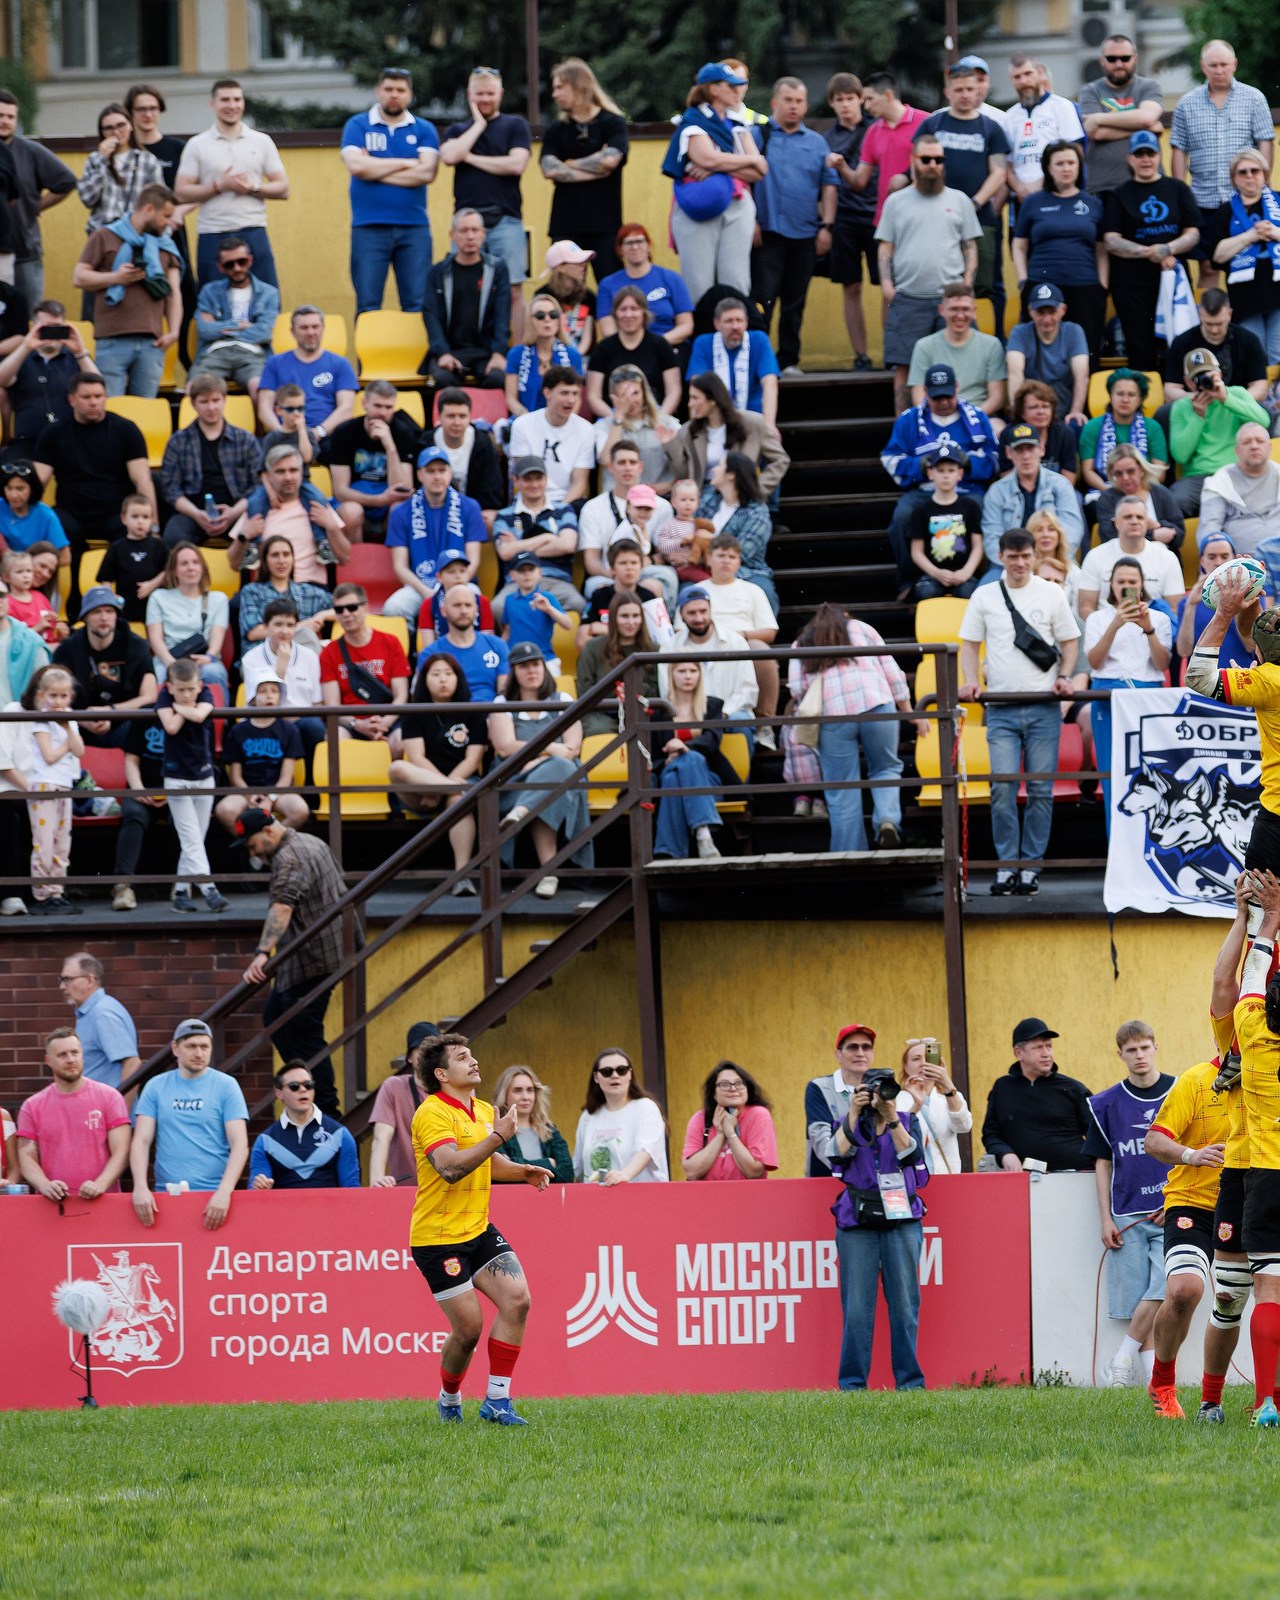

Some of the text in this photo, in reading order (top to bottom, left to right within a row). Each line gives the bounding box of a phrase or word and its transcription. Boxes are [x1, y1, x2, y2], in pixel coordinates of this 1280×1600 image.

[1176, 720, 1261, 742] ДОБР
[207, 1246, 420, 1280] Департамен
[675, 1226, 943, 1292] МОСКОВЙ
[209, 1291, 328, 1323] спорта
[676, 1295, 802, 1345] СПОРТ
[210, 1327, 474, 1365] города Москв
